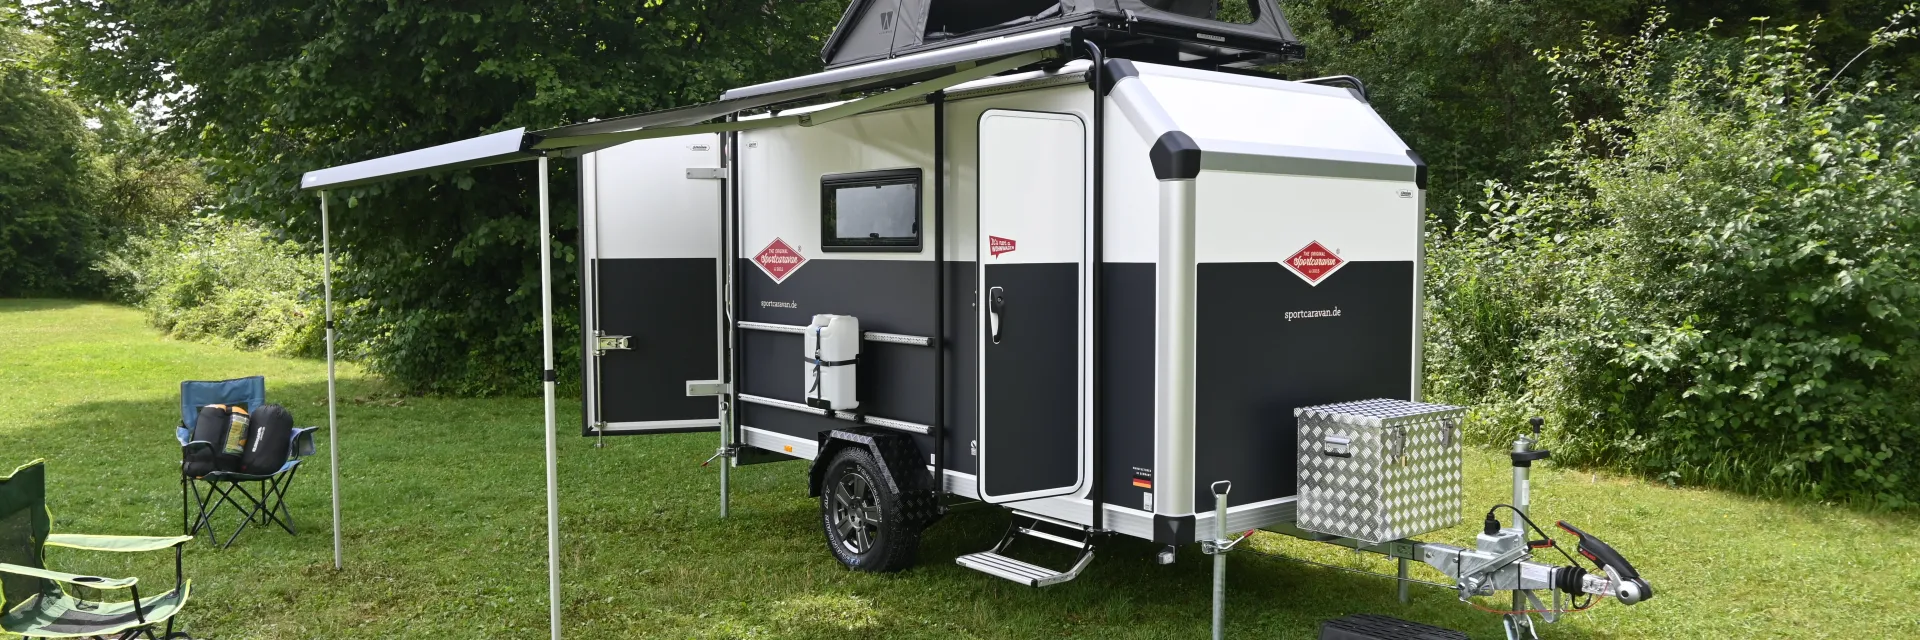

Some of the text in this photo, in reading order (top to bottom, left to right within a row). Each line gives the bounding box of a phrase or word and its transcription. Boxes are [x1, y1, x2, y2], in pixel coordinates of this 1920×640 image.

[1293, 256, 1336, 268] Sportcaravan
[761, 300, 798, 309] sportcaravan.de
[1284, 306, 1342, 322] sportcaravan.de
